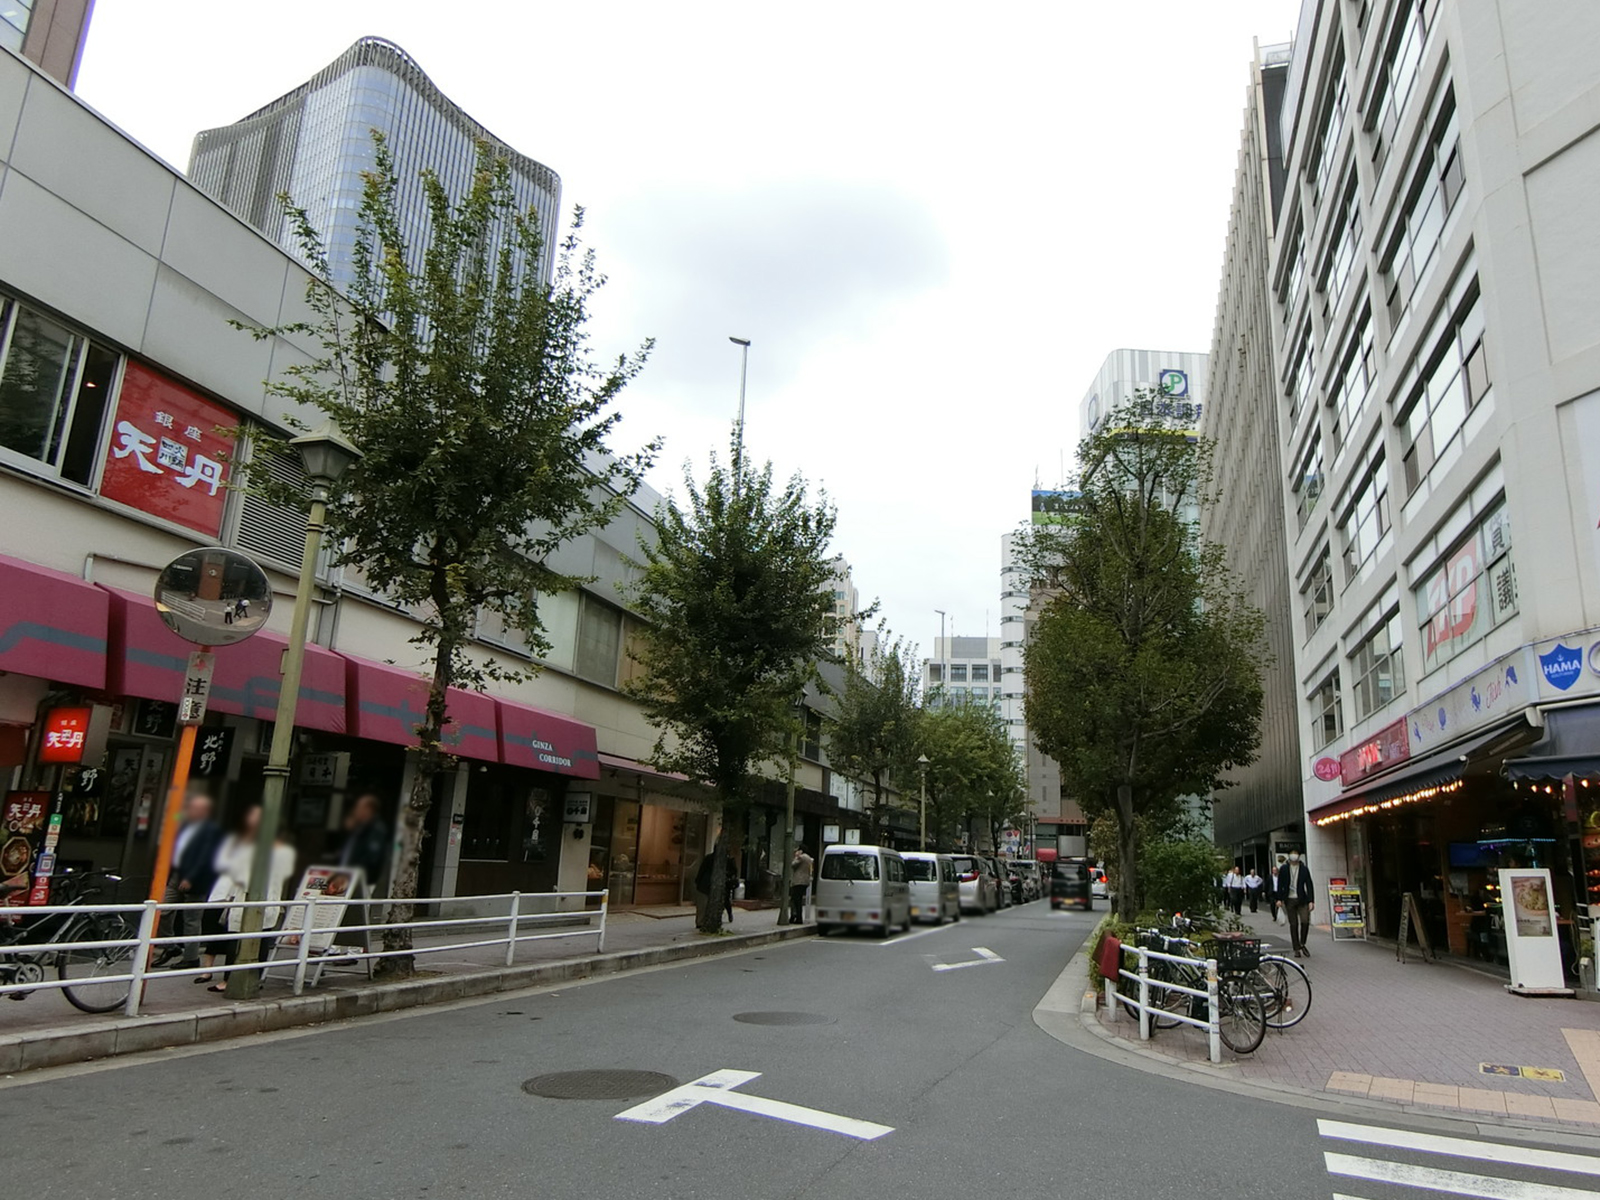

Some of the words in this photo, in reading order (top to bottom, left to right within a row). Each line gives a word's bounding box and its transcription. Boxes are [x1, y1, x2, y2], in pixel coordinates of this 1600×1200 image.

[155, 410, 204, 442] 銀座
[1543, 659, 1581, 675] HAMA
[532, 739, 553, 752] GINZA
[539, 753, 572, 767] CORRIDOR
